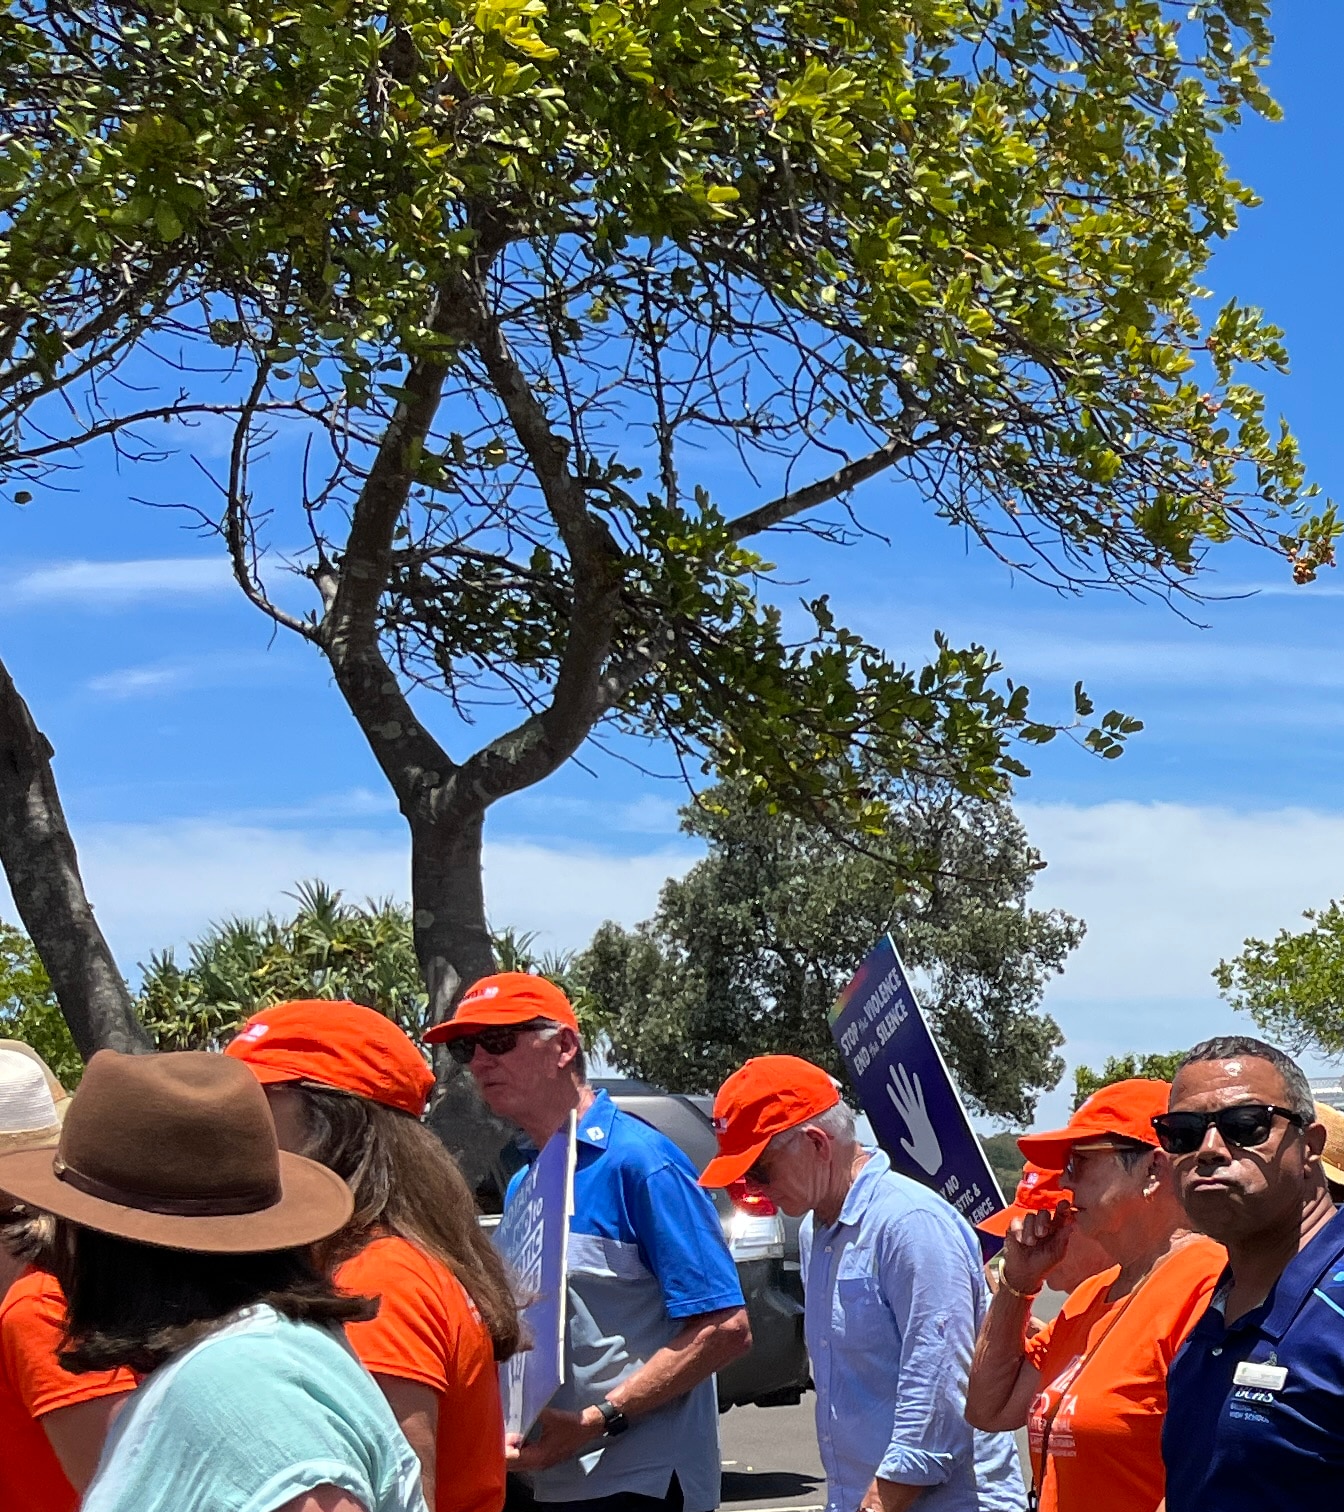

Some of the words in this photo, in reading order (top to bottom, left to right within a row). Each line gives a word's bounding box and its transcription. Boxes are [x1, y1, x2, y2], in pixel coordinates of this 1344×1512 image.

[841, 1021, 859, 1056] STOP
[863, 966, 902, 1022] VIOLENCE
[854, 1046, 870, 1076] END
[876, 998, 908, 1046] SILENCE
[944, 1175, 960, 1197] NO
[1029, 1393, 1078, 1416] ZOTA
